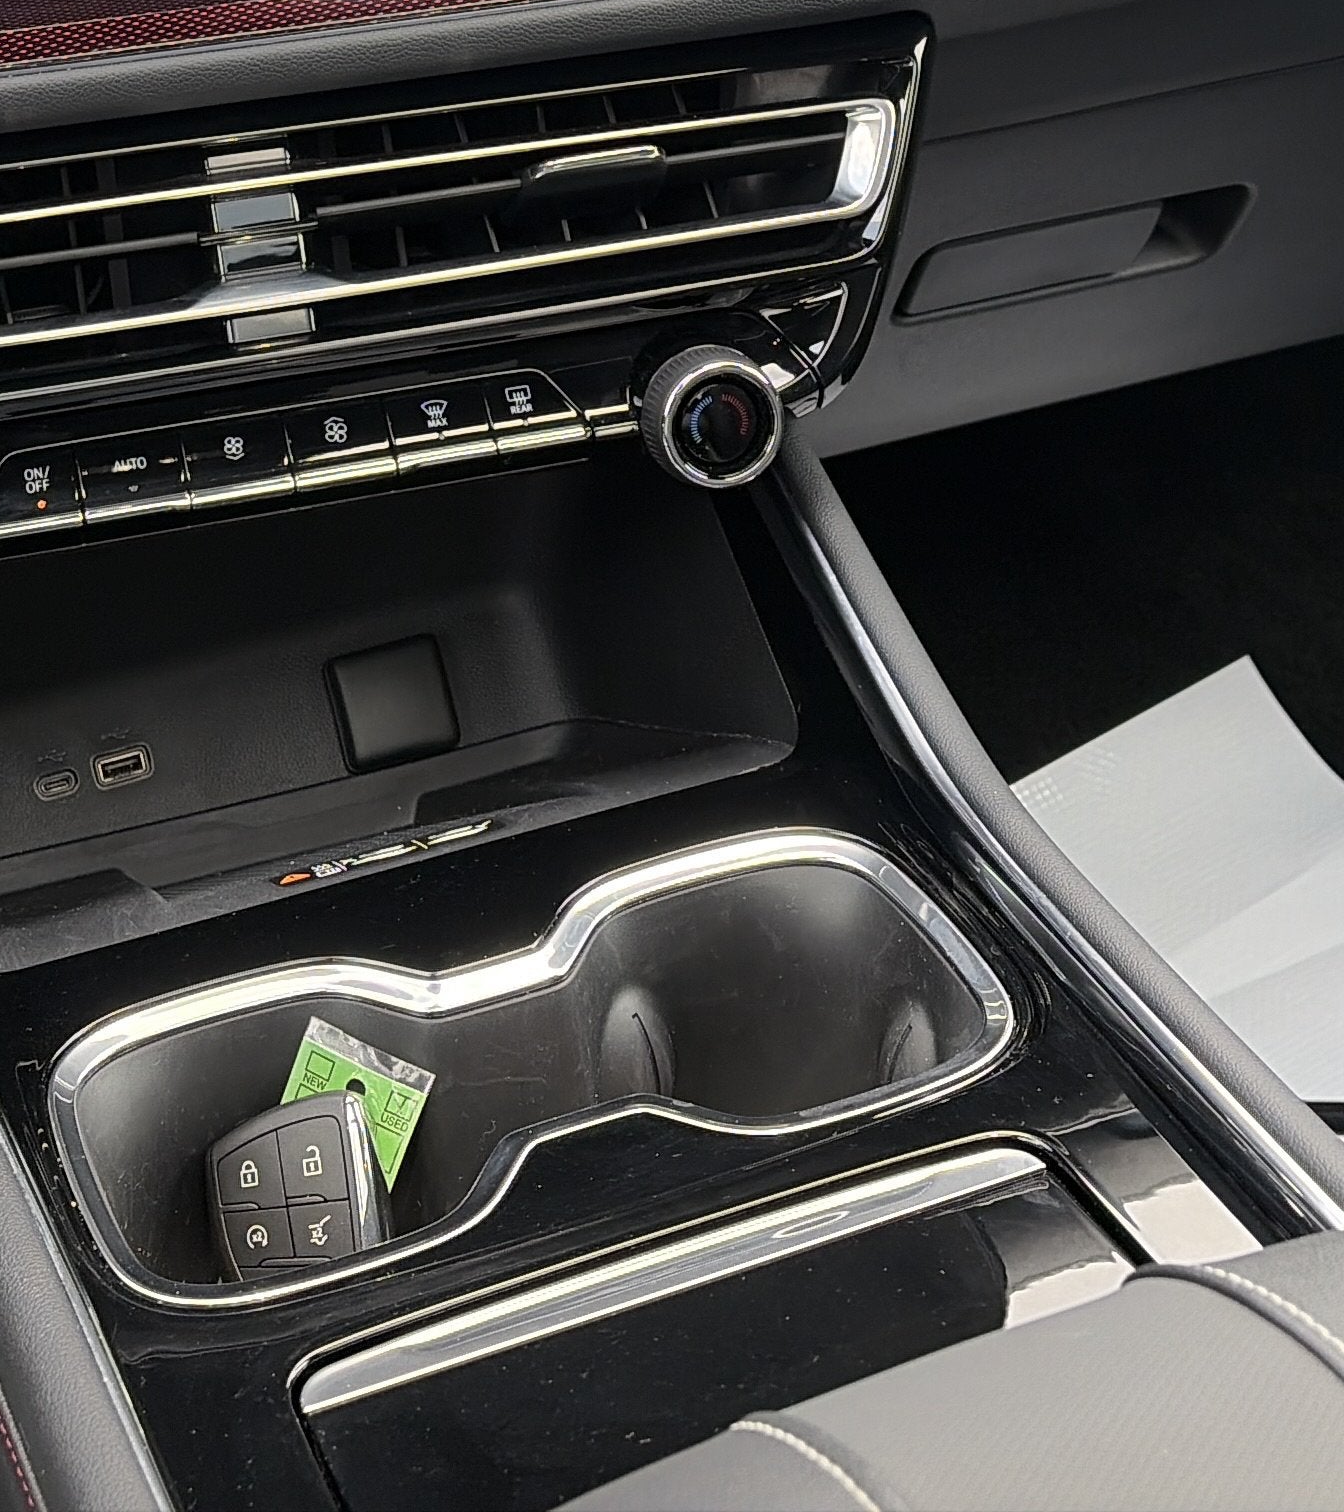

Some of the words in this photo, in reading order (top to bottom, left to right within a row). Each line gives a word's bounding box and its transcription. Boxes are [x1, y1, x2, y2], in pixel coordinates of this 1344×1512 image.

[509, 403, 534, 415] REAR
[427, 417, 449, 428] MAX
[113, 456, 148, 471] AUTO
[23, 464, 51, 482] ON/
[25, 478, 51, 495] OFF
[302, 1072, 328, 1091] NEW
[380, 1112, 410, 1133] USED
